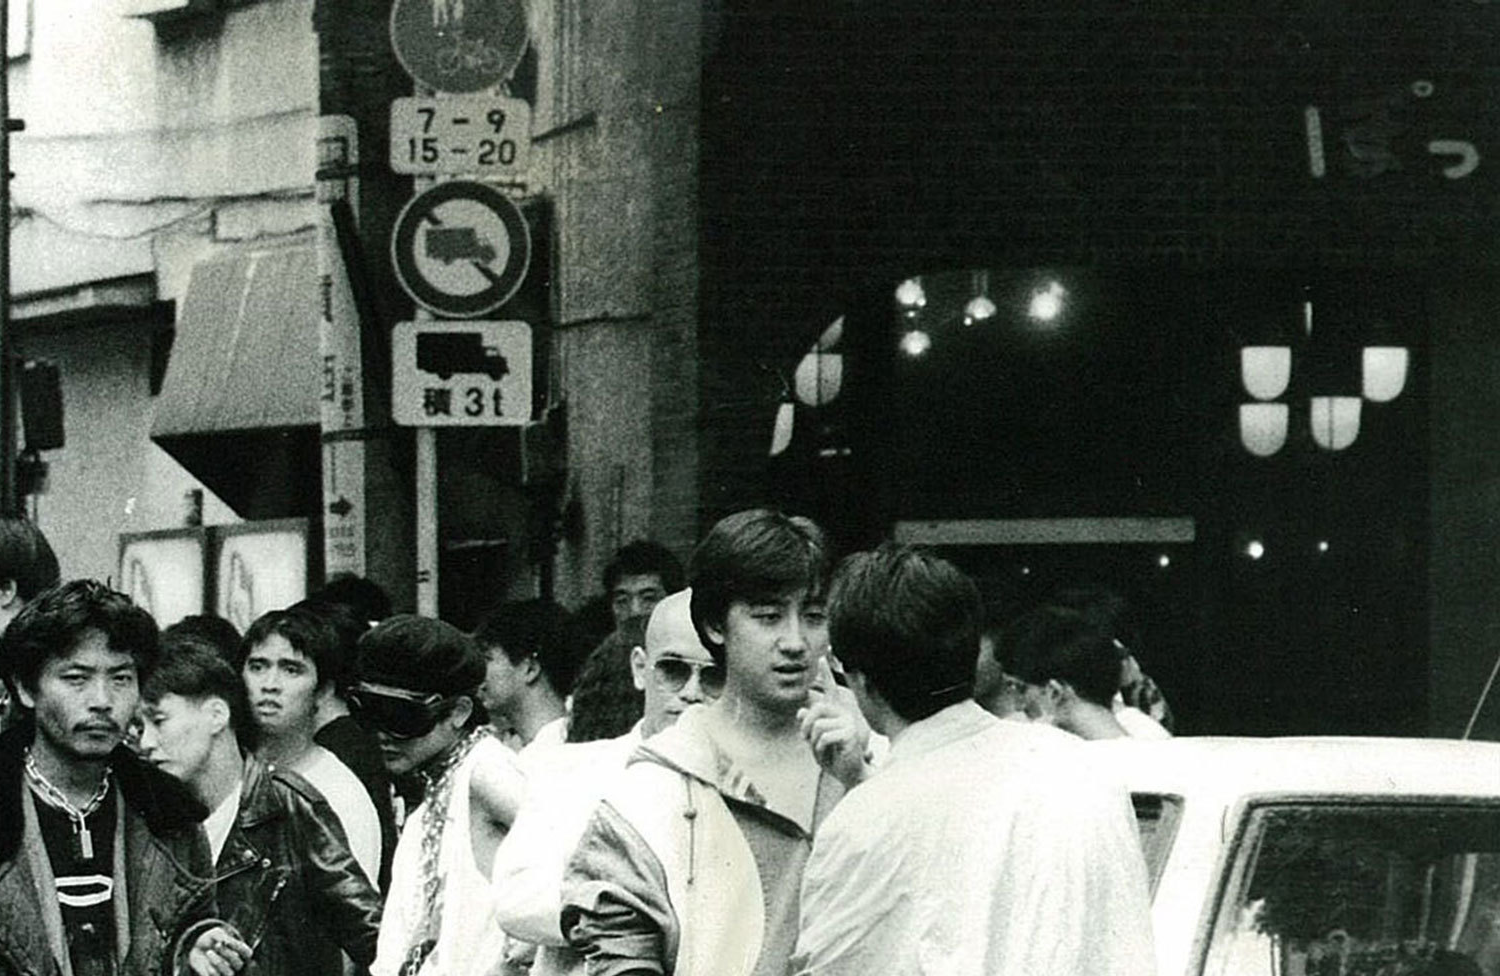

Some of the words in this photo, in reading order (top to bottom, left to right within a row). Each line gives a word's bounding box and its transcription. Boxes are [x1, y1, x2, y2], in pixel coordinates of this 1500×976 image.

[417, 108, 435, 133] 7
[486, 109, 505, 133] 9
[409, 137, 438, 163] 15
[478, 139, 516, 165] 20
